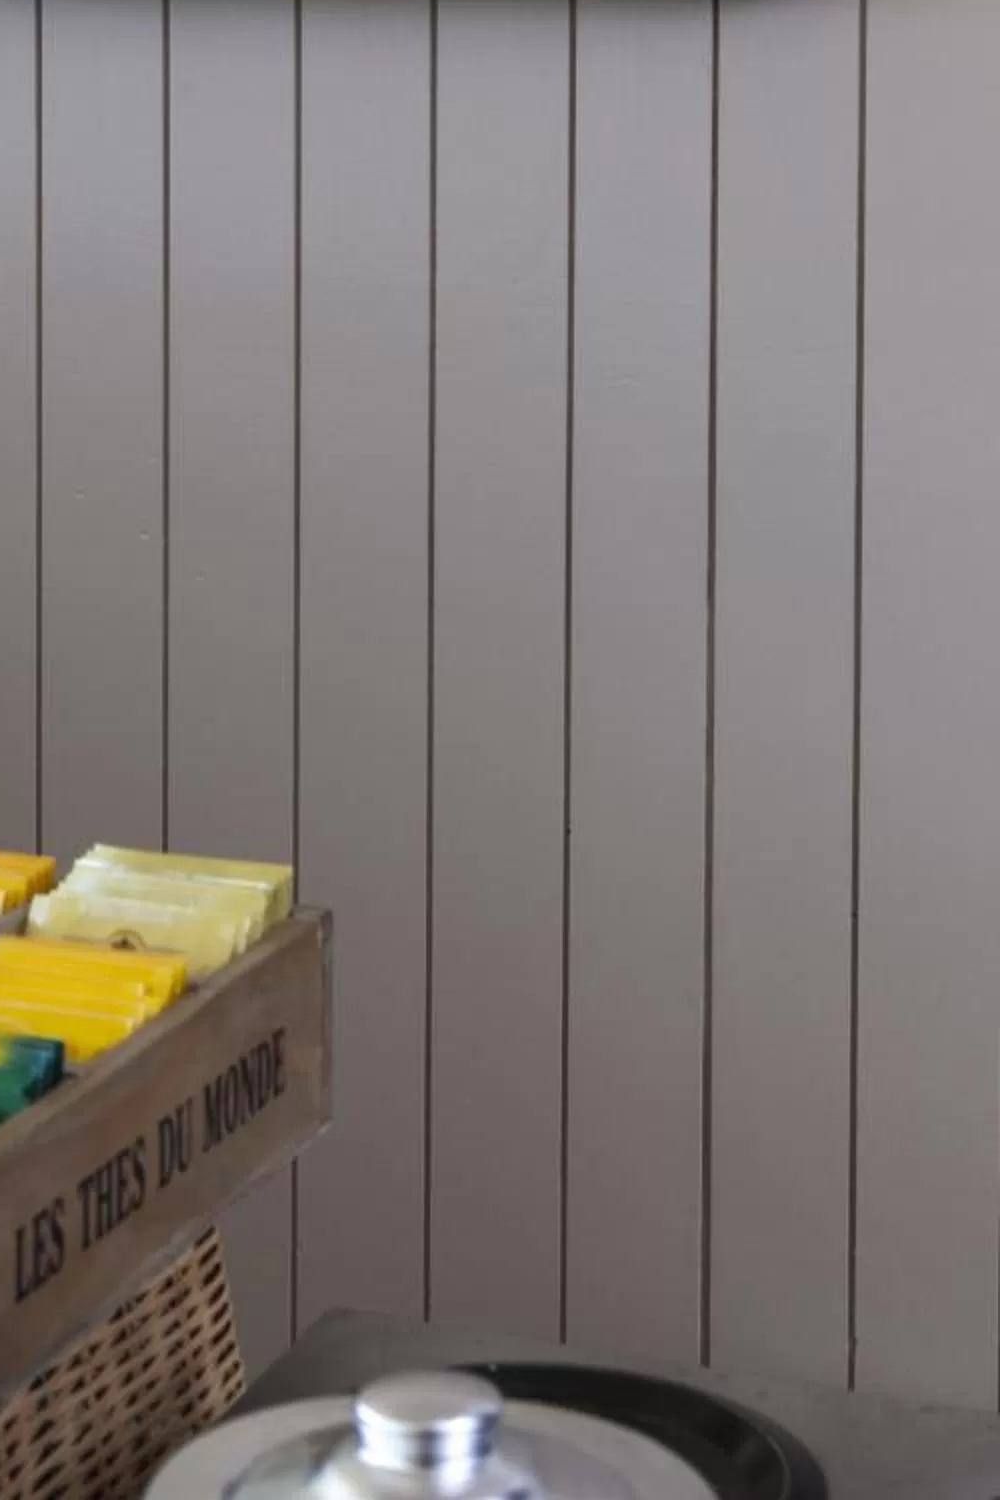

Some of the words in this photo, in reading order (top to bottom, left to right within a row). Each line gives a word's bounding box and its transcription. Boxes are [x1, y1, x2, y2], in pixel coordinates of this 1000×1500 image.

[14, 1196, 65, 1303] LES
[76, 1135, 146, 1252] THES
[157, 1097, 194, 1189] DU
[202, 1025, 286, 1154] MONDE
